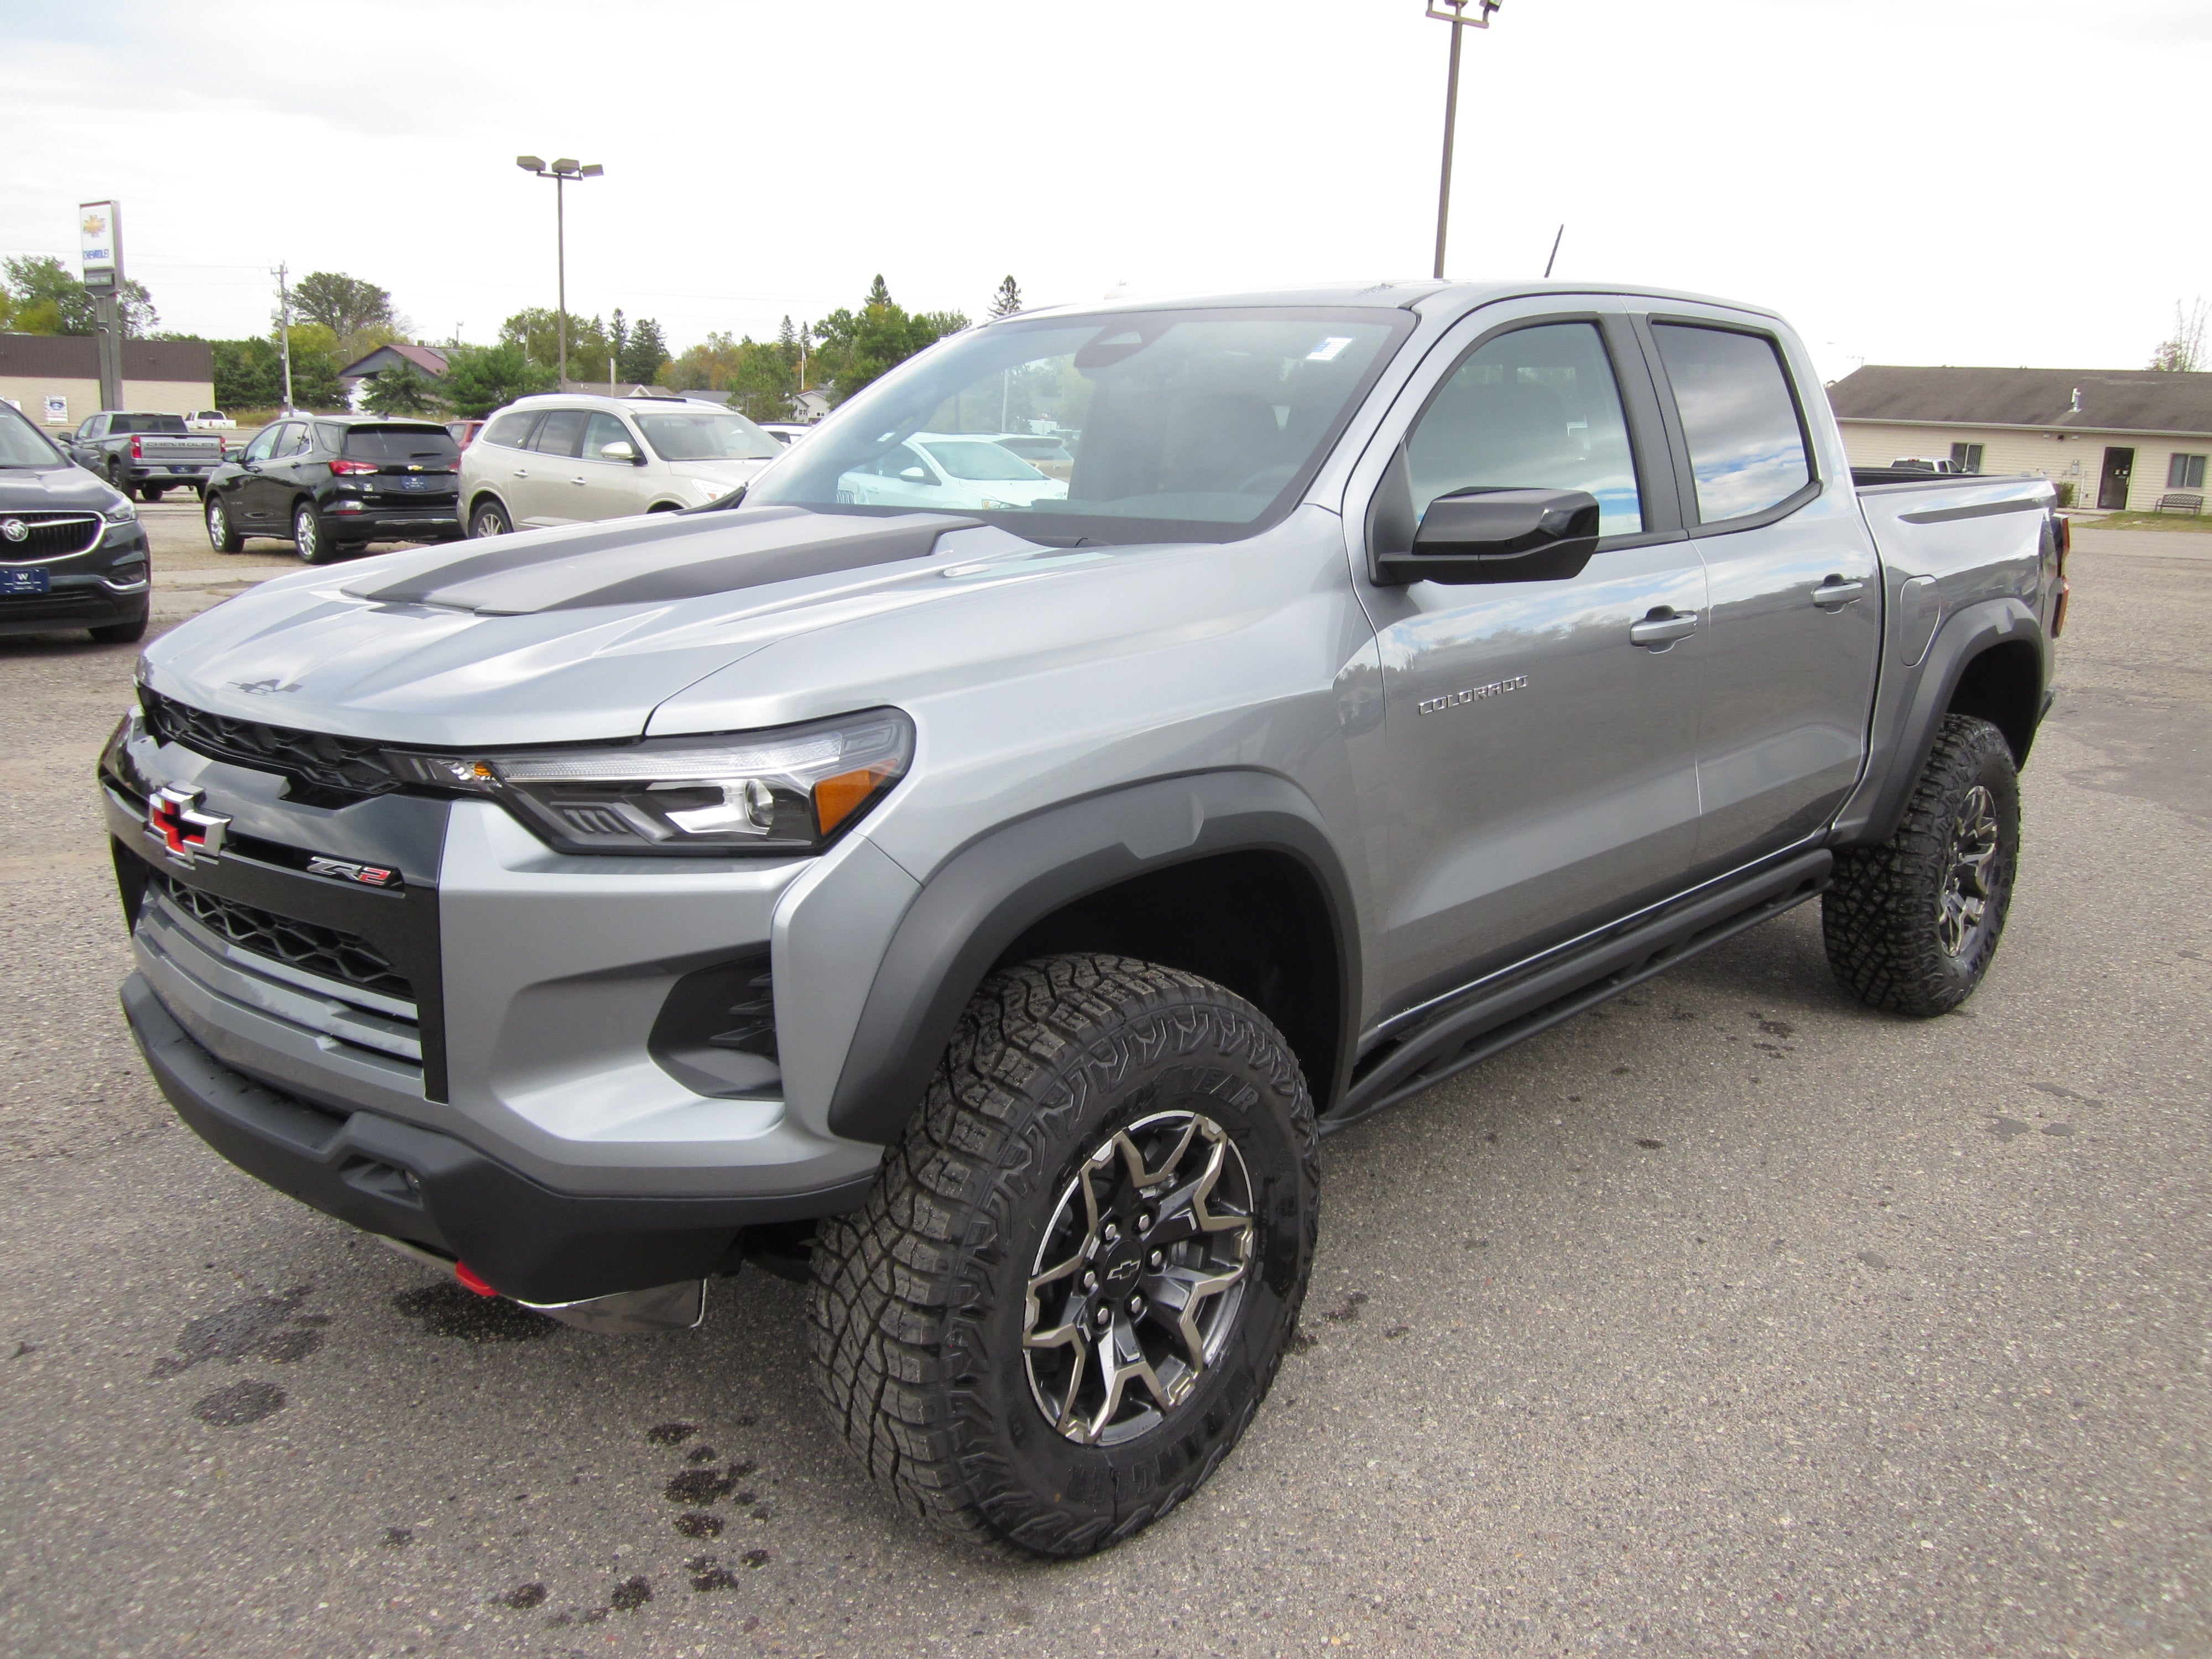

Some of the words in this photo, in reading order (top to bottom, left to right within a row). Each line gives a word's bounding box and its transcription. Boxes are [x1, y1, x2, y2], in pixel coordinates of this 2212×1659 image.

[83, 249, 109, 260] CHEVROLET
[15, 572, 29, 581] W
[1418, 675, 1528, 715] COLORADO
[306, 856, 391, 885] ZR2
